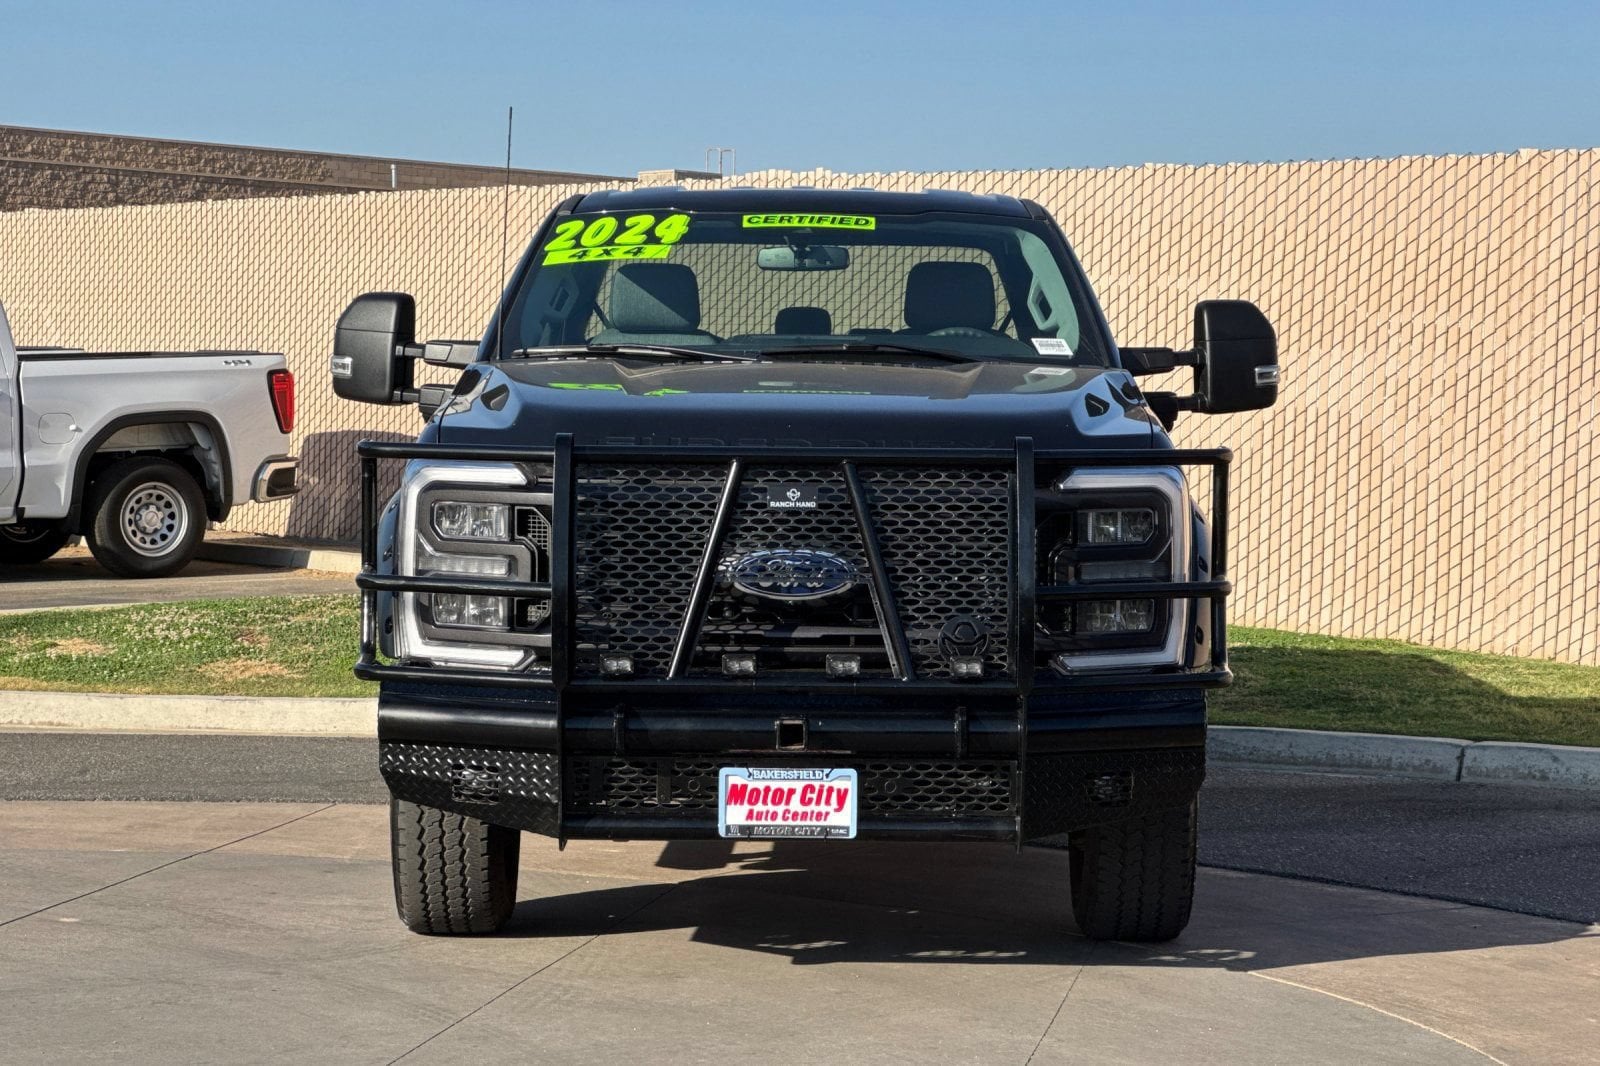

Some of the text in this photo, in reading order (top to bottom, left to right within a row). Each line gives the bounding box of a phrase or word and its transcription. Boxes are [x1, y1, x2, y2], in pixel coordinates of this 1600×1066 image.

[747, 215, 871, 226] CERTIFIED
[544, 214, 690, 250] 2024
[753, 769, 823, 779] BAKERSFIELD
[726, 783, 849, 812] Motor City
[746, 809, 830, 822] Auto Center
[753, 826, 821, 836] MOTOR CITY
